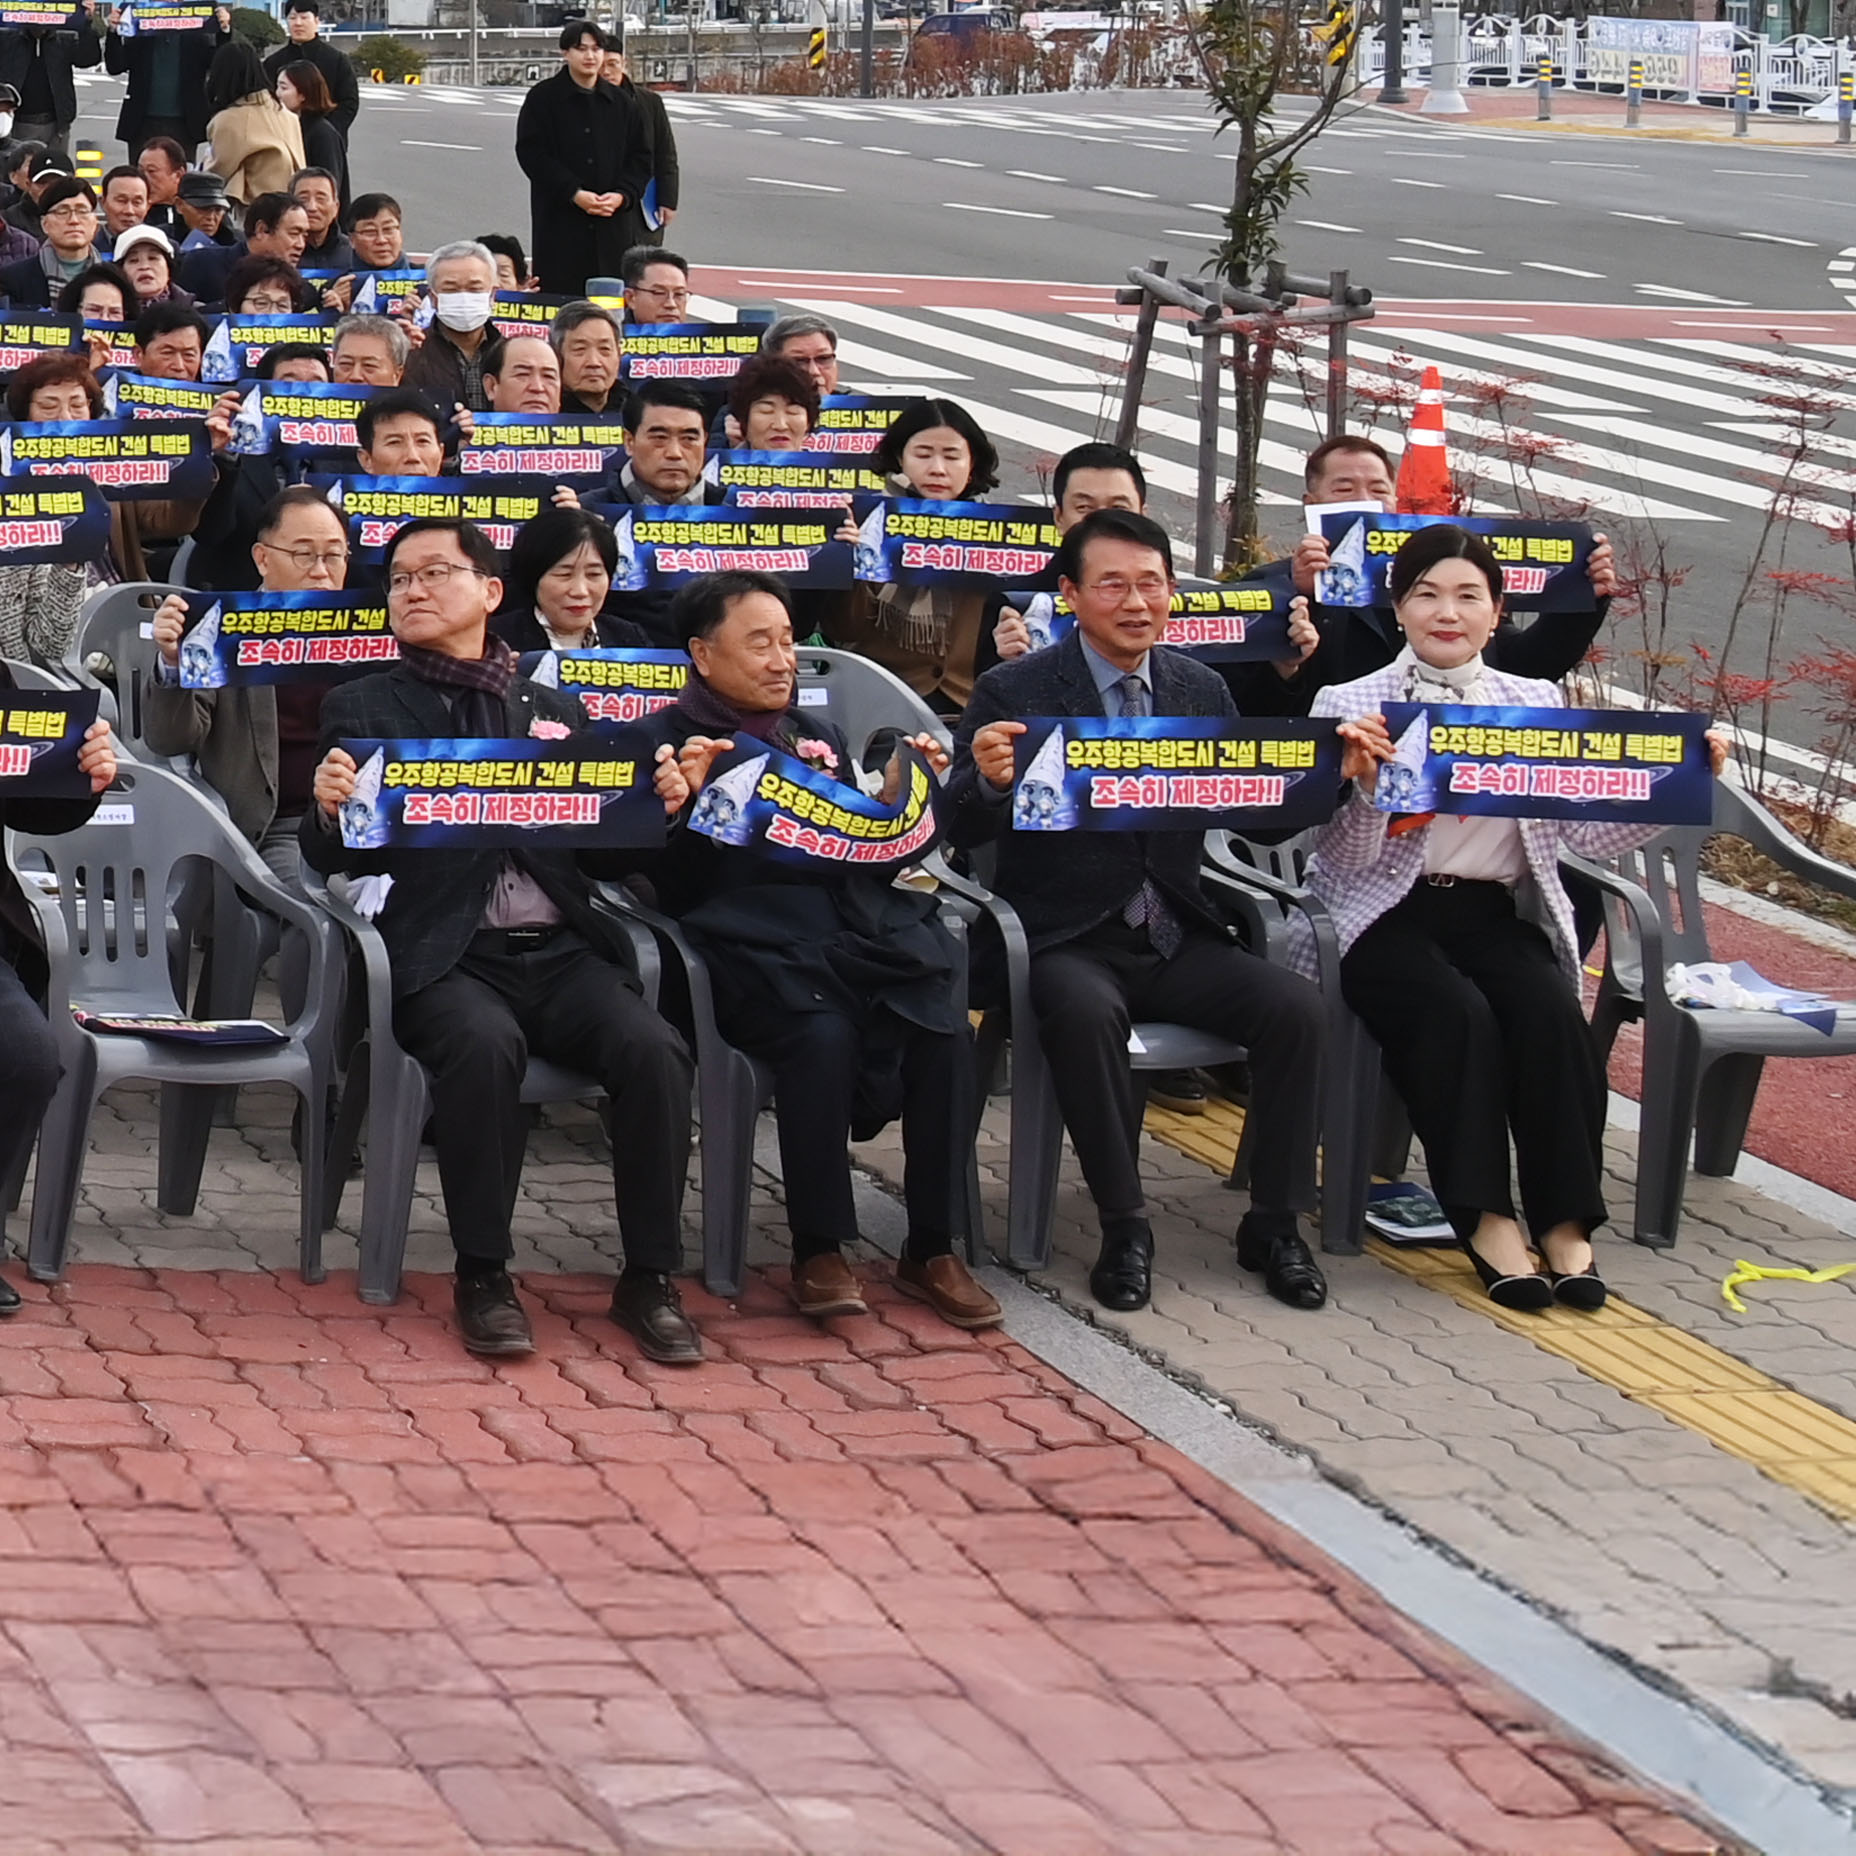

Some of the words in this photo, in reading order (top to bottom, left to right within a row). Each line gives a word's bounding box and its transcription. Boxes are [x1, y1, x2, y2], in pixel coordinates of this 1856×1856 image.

[7, 325, 31, 345] 건설
[34, 326, 71, 347] 특별법
[705, 336, 726, 354] 건설
[725, 336, 759, 354] 특별법
[631, 359, 677, 377] 조속히
[676, 358, 742, 377] 제정하라!!
[13, 436, 119, 459] 우주항공복합도시
[122, 435, 148, 457] 건설
[149, 434, 191, 456] 특별법
[556, 427, 581, 446] 건설
[585, 427, 625, 445] 특별법
[86, 461, 170, 485] 제정하라!!
[462, 451, 515, 472] 조속히
[518, 450, 601, 472] 제정하라!!
[7, 493, 36, 517] 건설
[37, 492, 85, 515] 특별법
[345, 492, 460, 518] 우주항공복합도시
[463, 495, 493, 519] 건설
[497, 496, 539, 520] 특별법
[635, 522, 748, 545] 우주항공복합도시
[752, 524, 780, 546] 건설
[783, 524, 827, 546] 특별법
[887, 514, 1004, 543] 우주항공복합도시
[1008, 522, 1038, 546] 건설
[658, 550, 714, 570] 조속히
[717, 550, 807, 573] 제정하라!!
[903, 544, 962, 569] 조속히
[1495, 536, 1524, 561] 건설
[1525, 537, 1573, 563] 특별법
[1184, 591, 1220, 612] 건설
[1220, 589, 1274, 611] 특별법
[223, 610, 350, 634] 우주항공복합도시
[352, 608, 386, 631] 건설
[239, 638, 306, 665] 조속히
[561, 659, 689, 689] 우주항공복합도시
[582, 693, 645, 721] 조속히
[8, 710, 67, 738] 특별법
[1068, 739, 1215, 769] 우주항공복합도시
[1220, 740, 1257, 768] 건설
[1260, 740, 1316, 768] 특별법
[1432, 727, 1580, 758] 우주항공복합도시
[1585, 732, 1622, 761] 건설
[1627, 734, 1683, 763] 특별법
[385, 761, 534, 788] 우주항공복합도시
[537, 761, 576, 787] 건설
[578, 761, 635, 787] 특별법
[1452, 764, 1527, 794] 조속히
[1533, 767, 1648, 798] 제정하라!!
[1094, 776, 1170, 806] 조속히
[1171, 776, 1283, 807] 제정하라!!
[405, 794, 480, 823] 조속히
[484, 794, 599, 824] 제정하라!!
[757, 773, 904, 838] 우주항공복합도시
[765, 814, 850, 861] 조속히
